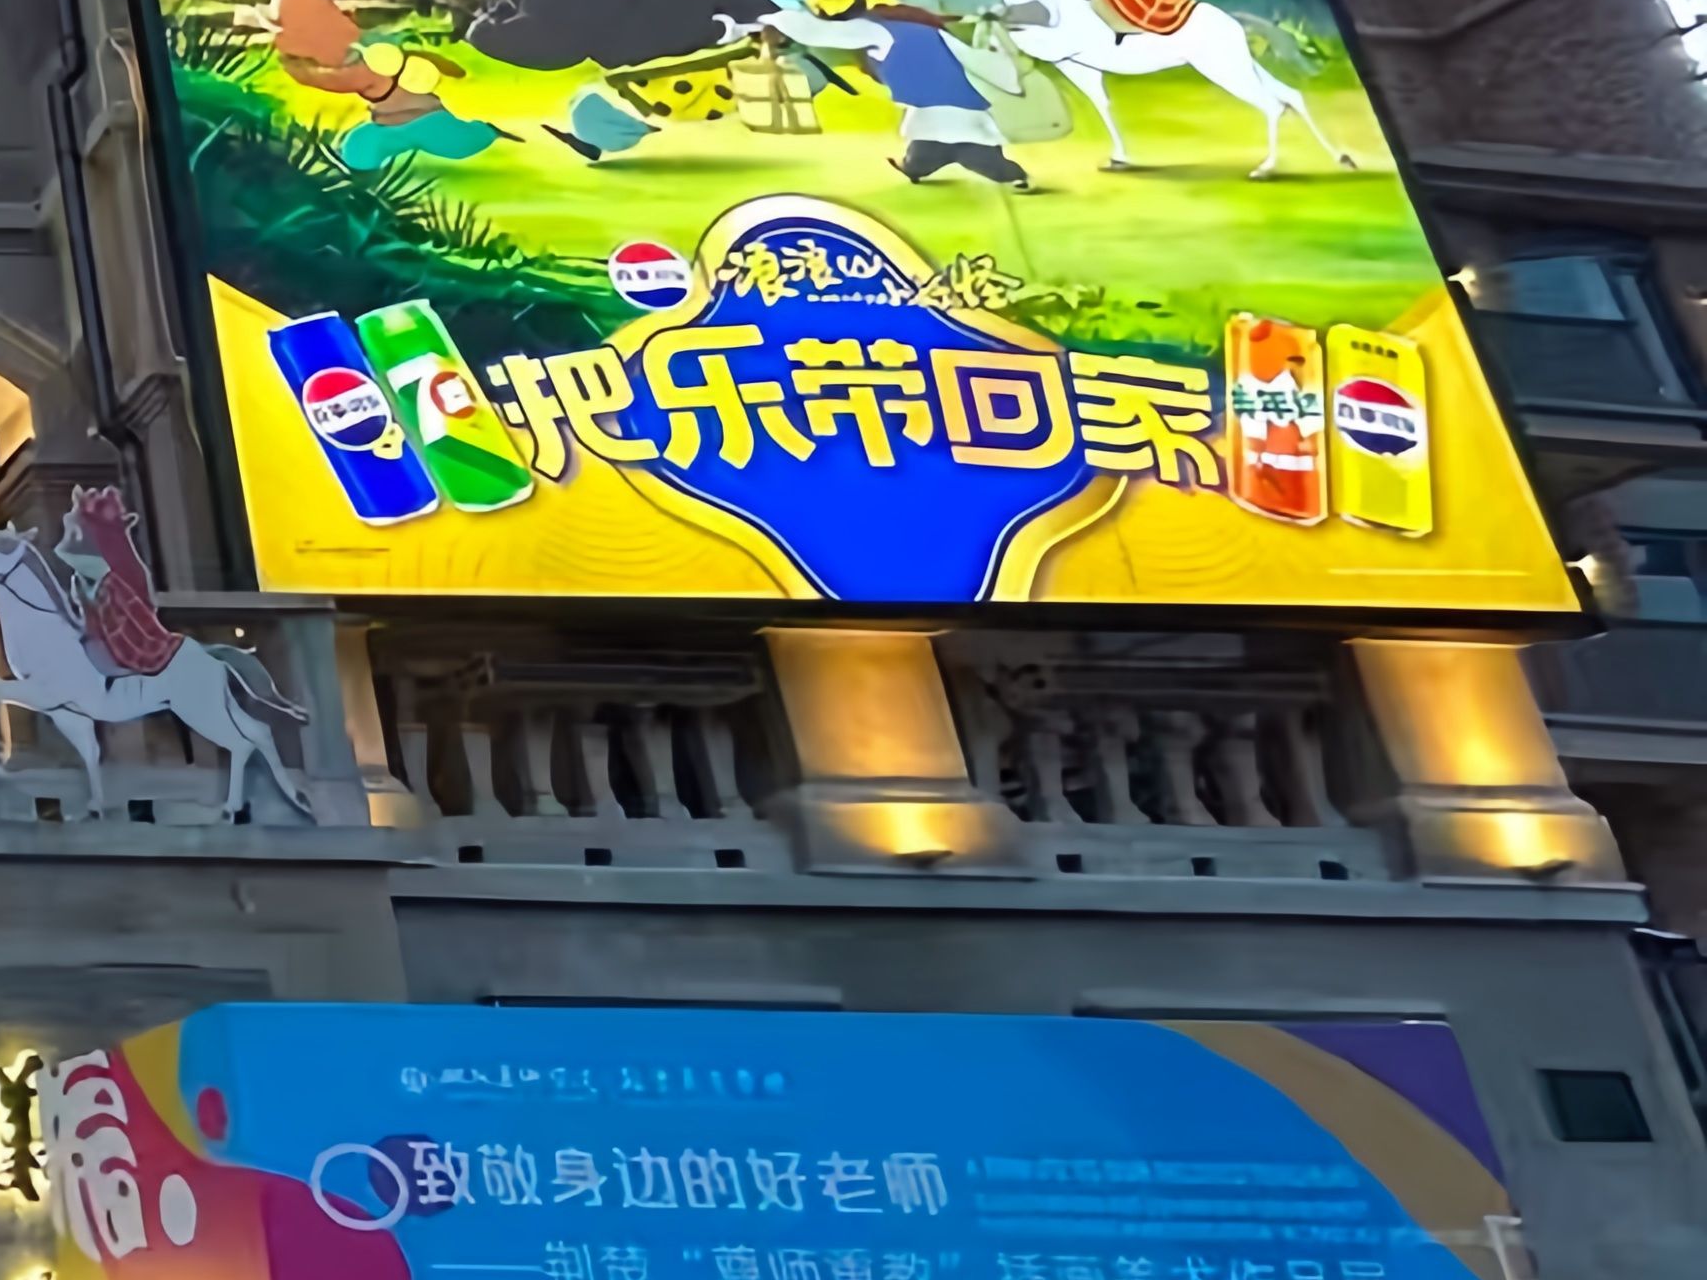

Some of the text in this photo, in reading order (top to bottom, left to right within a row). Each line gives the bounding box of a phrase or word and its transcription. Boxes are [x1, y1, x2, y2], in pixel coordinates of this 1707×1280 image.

[488, 323, 1223, 486] 把乐带回家
[408, 1140, 949, 1216] 致敬身边的好老师
